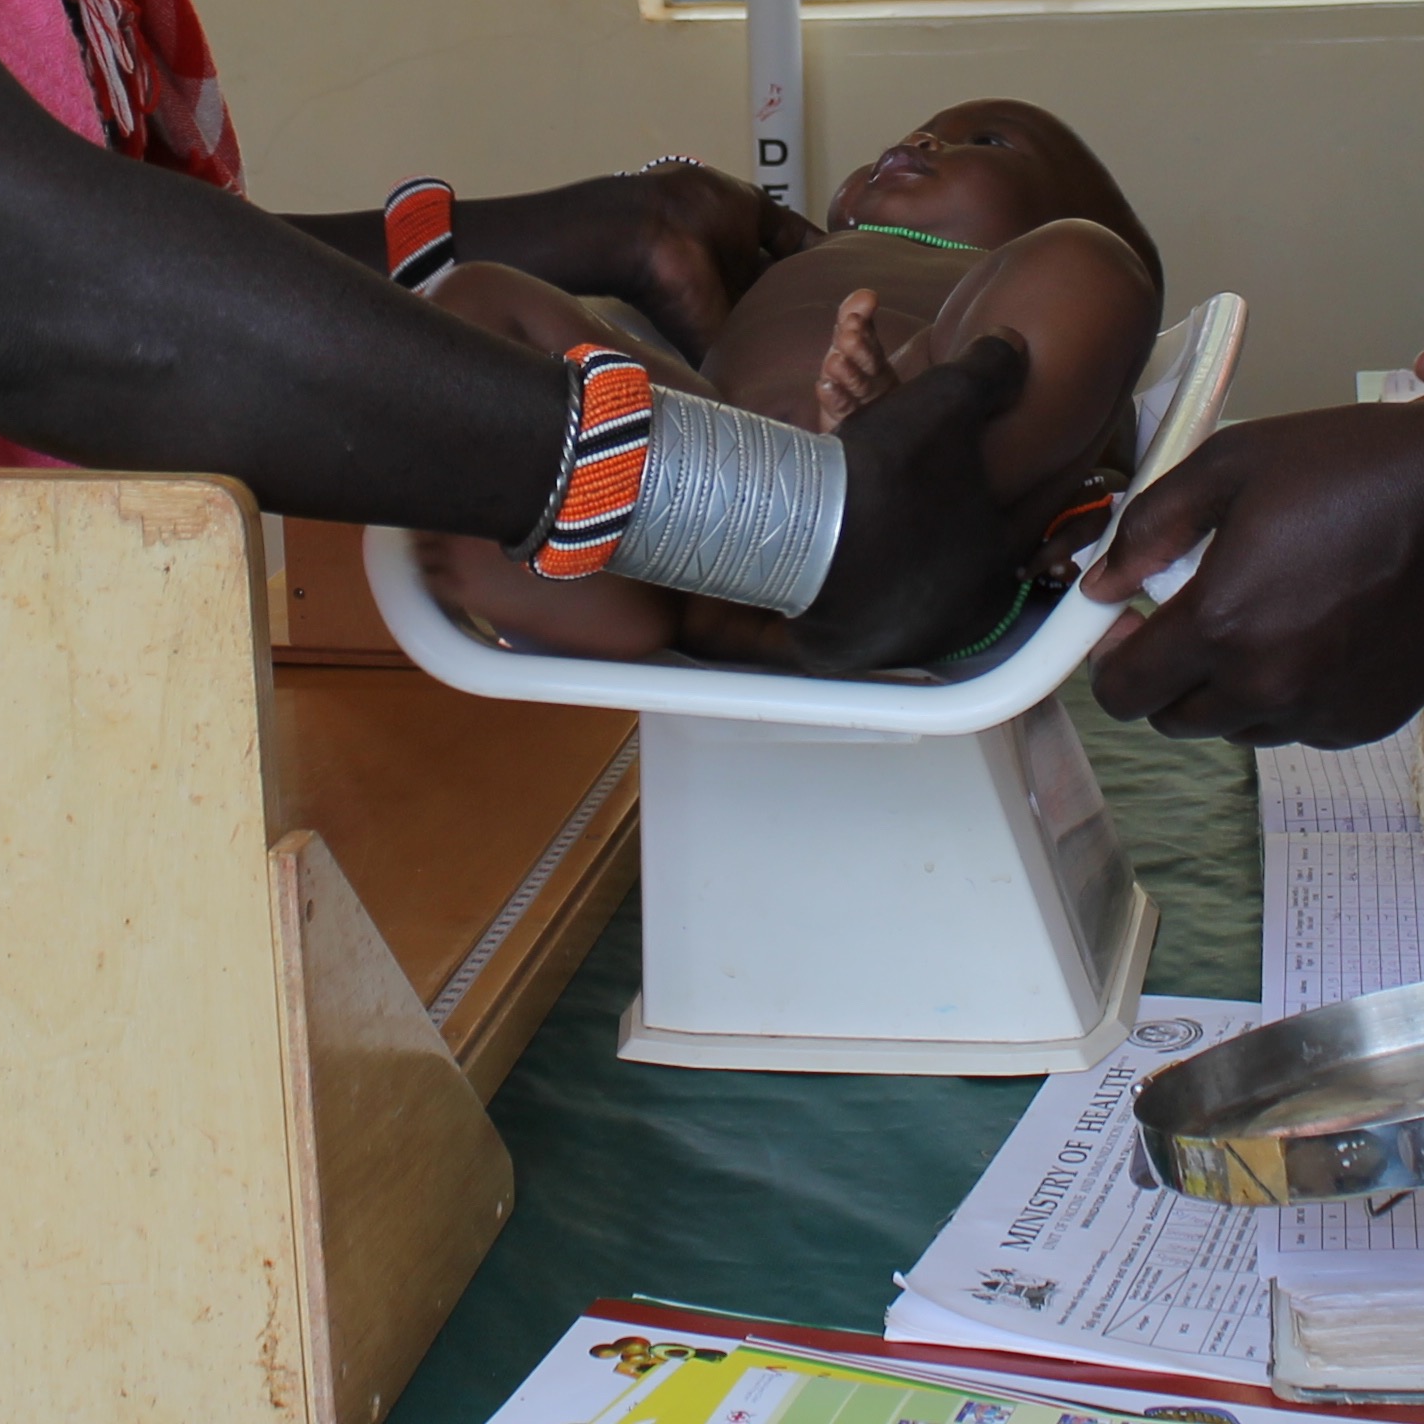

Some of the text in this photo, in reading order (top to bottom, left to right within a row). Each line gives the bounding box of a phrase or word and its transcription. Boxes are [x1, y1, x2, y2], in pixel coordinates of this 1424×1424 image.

[1000, 1067, 1136, 1252] MINISTRY OF HEALTH
